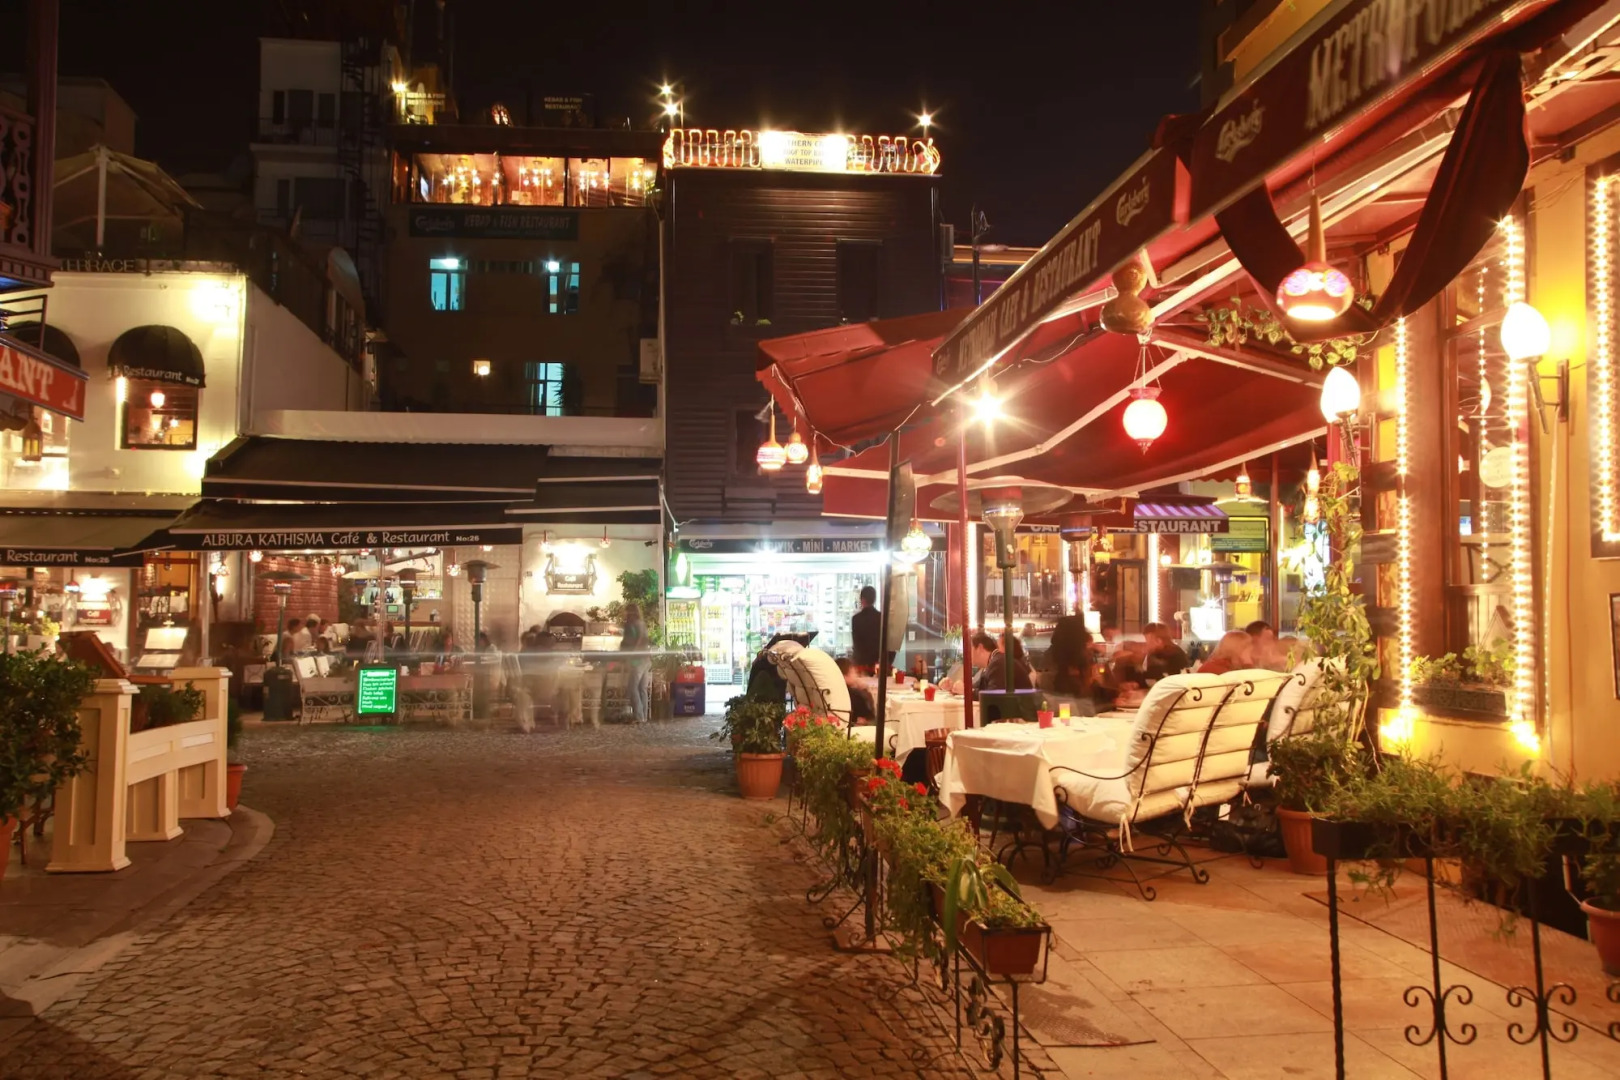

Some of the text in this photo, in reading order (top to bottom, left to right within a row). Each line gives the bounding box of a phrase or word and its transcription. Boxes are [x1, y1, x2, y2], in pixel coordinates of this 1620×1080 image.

[123, 365, 183, 381] Restaurant
[1117, 520, 1221, 533] ESTAURANT
[202, 532, 254, 547] ALBURA
[258, 531, 325, 546] KATHISMA
[331, 530, 360, 545] Café
[366, 532, 378, 545] &
[382, 530, 450, 544] Restaurant
[832, 540, 873, 553] MARKET
[7, 549, 79, 563] Restaurant
